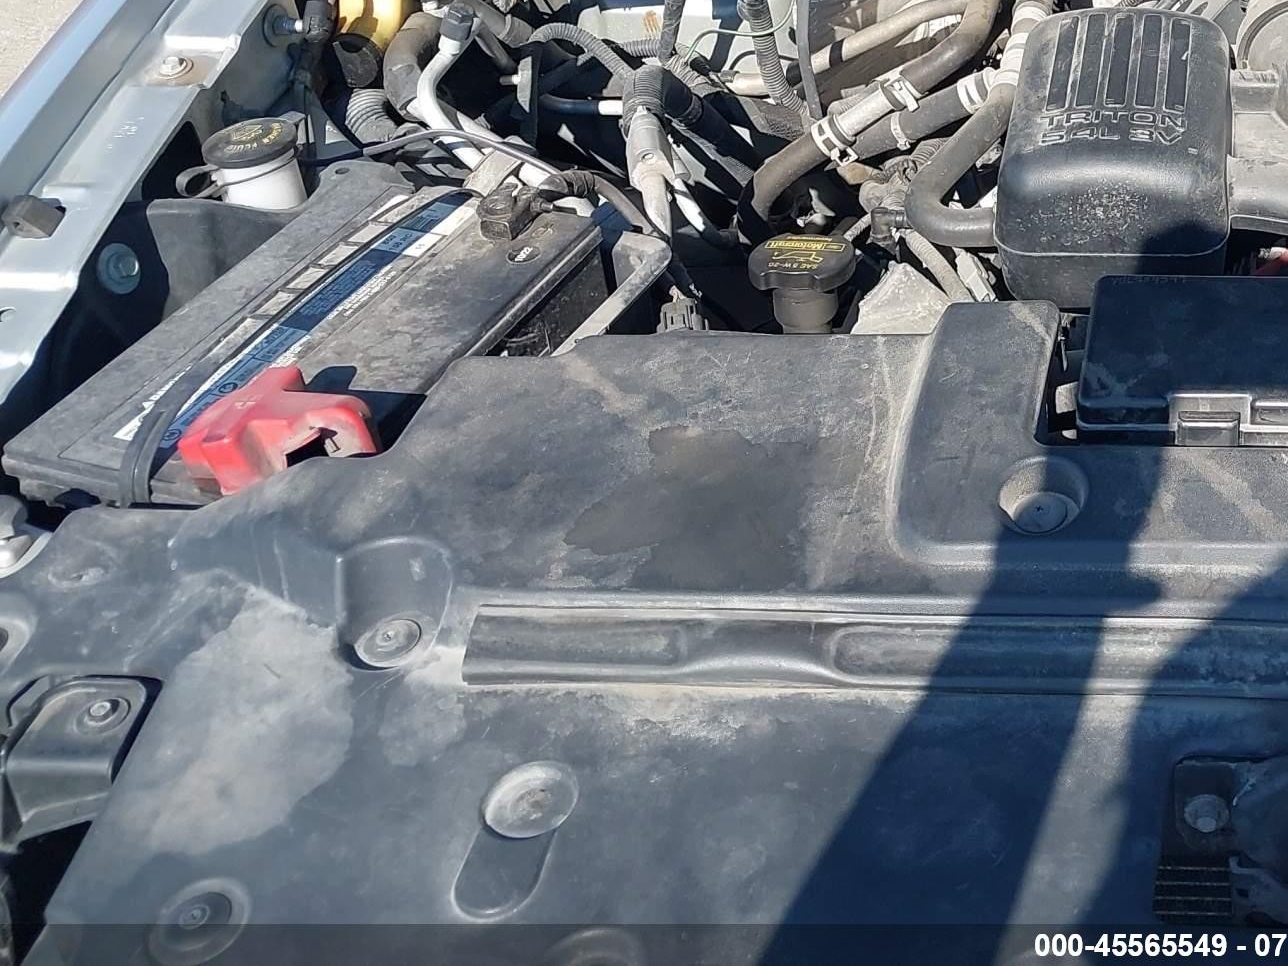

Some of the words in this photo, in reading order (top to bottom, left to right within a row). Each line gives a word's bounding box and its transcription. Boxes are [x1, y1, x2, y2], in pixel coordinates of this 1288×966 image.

[1037, 110, 1187, 132] TRITON
[1128, 128, 1183, 145] 3V
[769, 240, 824, 251] Motorcraft
[800, 262, 819, 270] SAE
